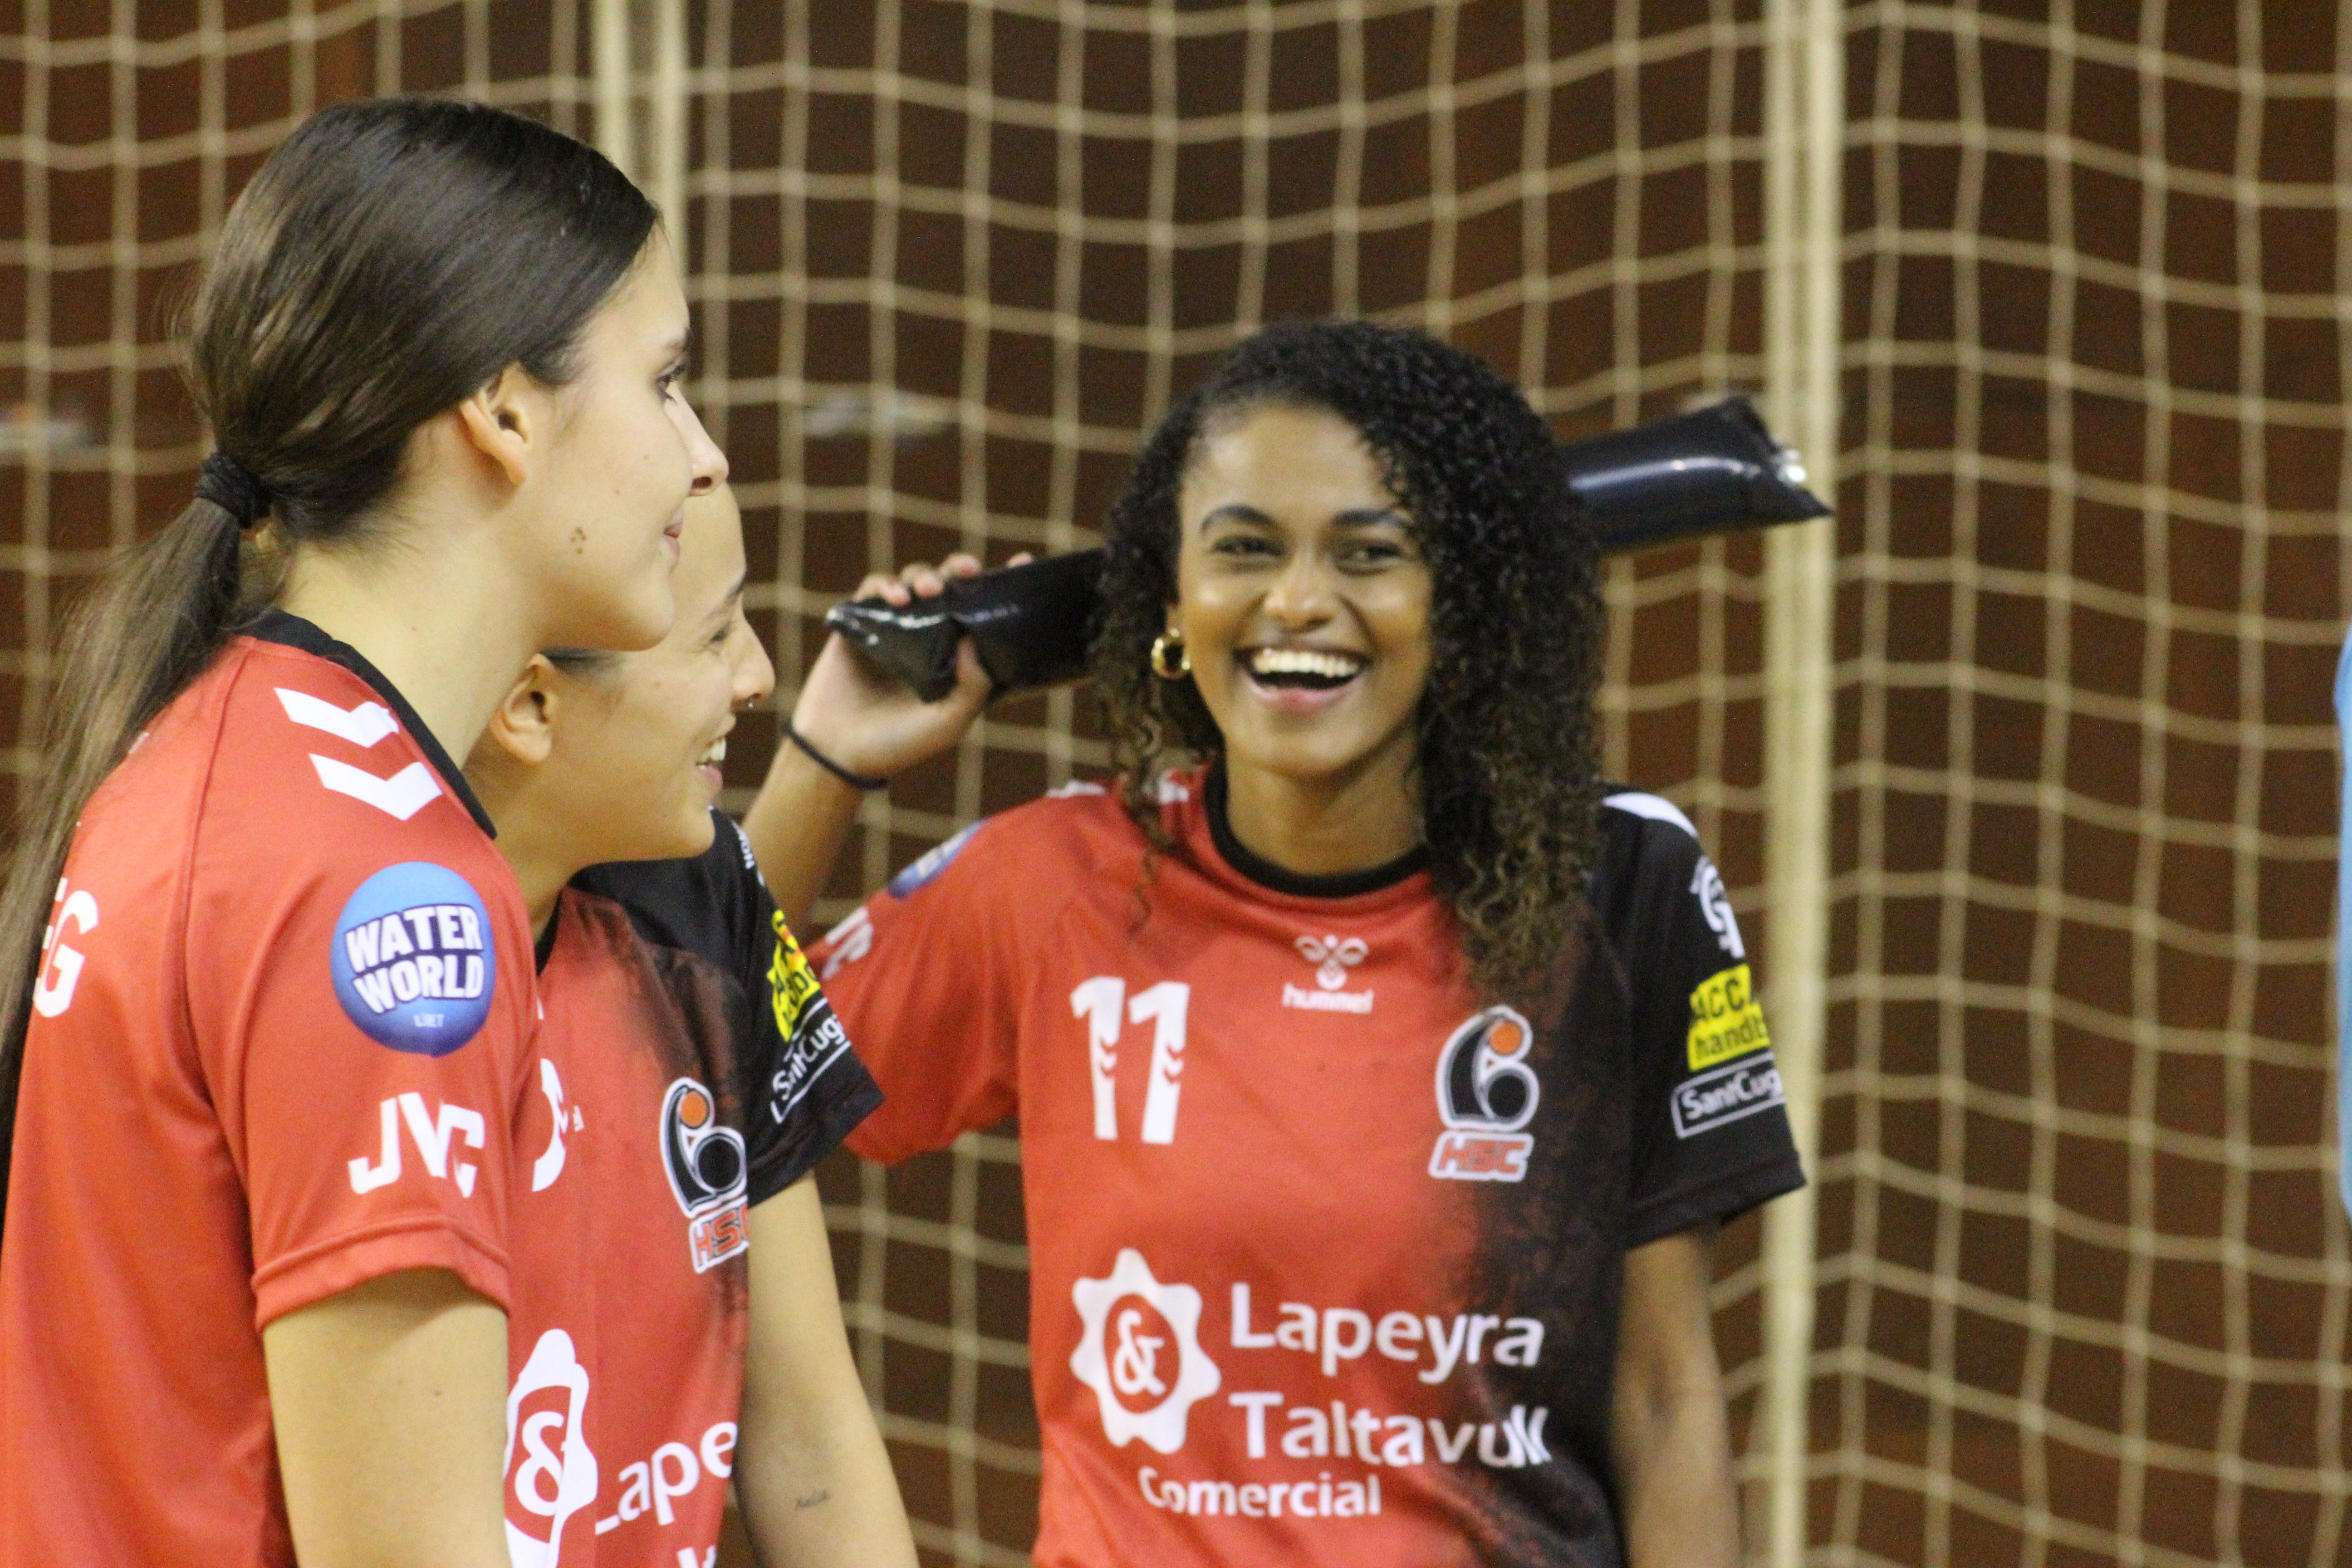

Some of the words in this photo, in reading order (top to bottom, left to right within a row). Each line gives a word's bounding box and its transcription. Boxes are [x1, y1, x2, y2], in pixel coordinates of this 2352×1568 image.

[345, 905, 484, 974] WATER
[352, 954, 485, 1014] WORLD
[1282, 982, 1375, 1014] hummel
[1070, 975, 1190, 1145] 11
[348, 1092, 485, 1198] JVC
[1434, 1135, 1529, 1177] HSC
[1230, 1282, 1545, 1385] Lapeyra
[1228, 1391, 1553, 1468] Taltavull
[1138, 1466, 1381, 1518] Comercial
